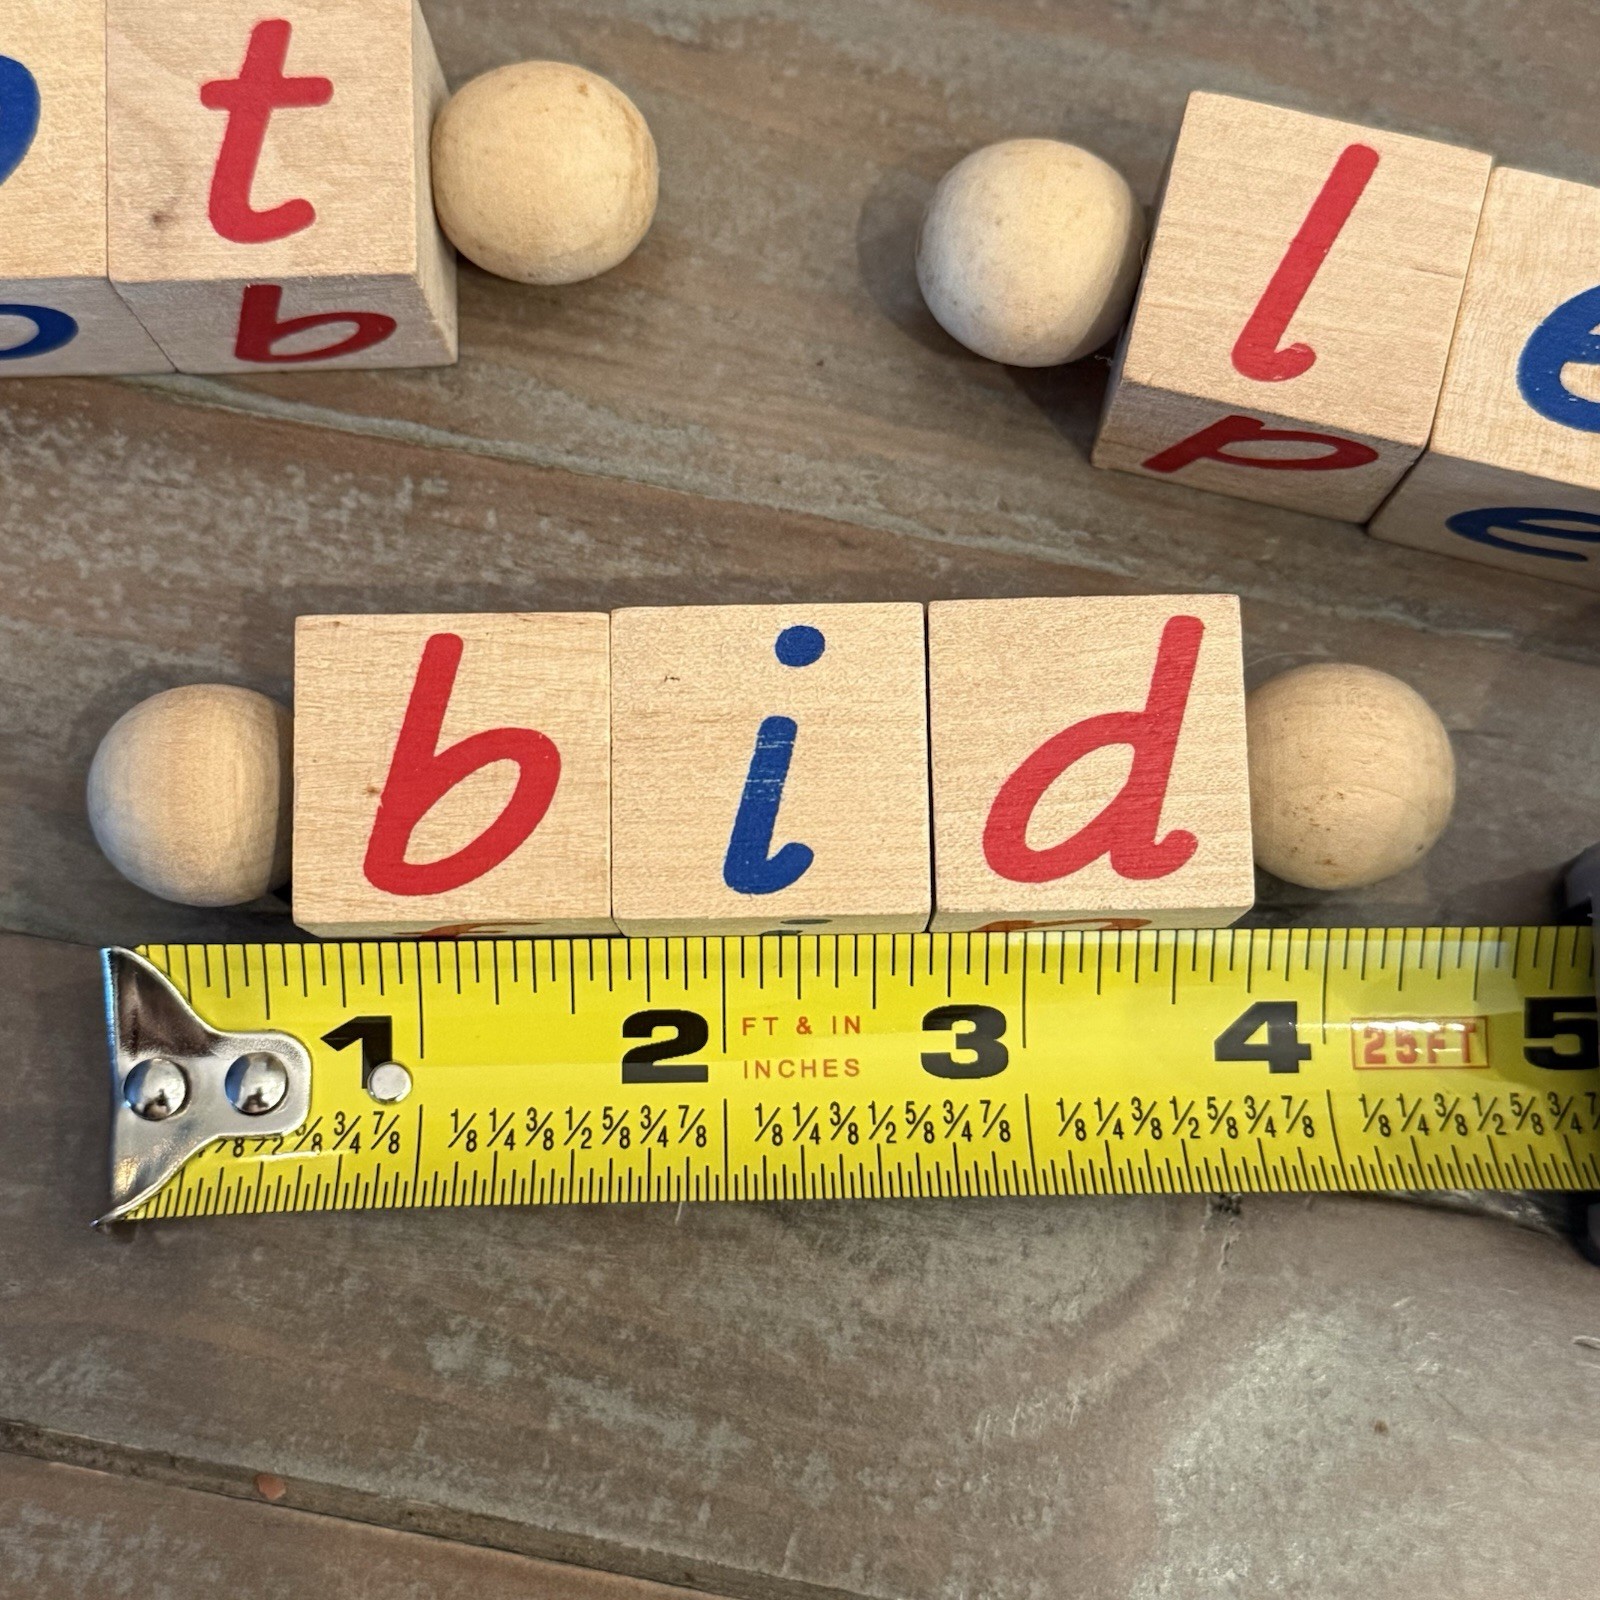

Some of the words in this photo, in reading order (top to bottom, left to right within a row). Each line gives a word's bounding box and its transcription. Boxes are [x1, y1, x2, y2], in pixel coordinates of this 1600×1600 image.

[363, 615, 1204, 896] bid
[621, 1009, 709, 1084] 2
[741, 1017, 779, 1036] FT
[796, 1016, 813, 1035] &
[831, 1015, 861, 1034] IN
[920, 1004, 1009, 1079] 3
[1214, 1000, 1312, 1074] 4
[1523, 996, 1598, 1071] 5
[743, 1058, 861, 1079] INCHES
[332, 1111, 362, 1154] 3/4
[370, 1111, 400, 1154] 7/8
[448, 1108, 478, 1152] 1/8
[487, 1108, 516, 1150] 1/4
[525, 1107, 554, 1150] 3/8
[564, 1106, 592, 1149] 1/2
[602, 1106, 630, 1148] 5/8
[640, 1104, 668, 1148] 3/4
[678, 1105, 708, 1148] 7/8
[754, 1102, 783, 1146] 1/8
[792, 1102, 820, 1145] 1/4
[830, 1102, 858, 1145] 3/8
[868, 1100, 896, 1144] 1/2
[905, 1100, 934, 1144] 5/8
[943, 1100, 972, 1142] 3/4
[980, 1100, 1010, 1142] 7/8
[1056, 1097, 1086, 1140] 1/8
[1094, 1097, 1124, 1140] 1/4
[1131, 1096, 1162, 1140] 3/8
[1169, 1096, 1200, 1138] 1/2
[1207, 1096, 1238, 1138] 5/8
[1244, 1095, 1276, 1137] 3/4
[1282, 1096, 1314, 1138] 7/8
[1358, 1093, 1390, 1137] 1/8
[1396, 1092, 1429, 1136] 1/4
[1434, 1093, 1467, 1136] 3/8
[1472, 1092, 1506, 1135] 1/2
[1510, 1092, 1544, 1136] 5/8
[1547, 1092, 1582, 1134] 3/4
